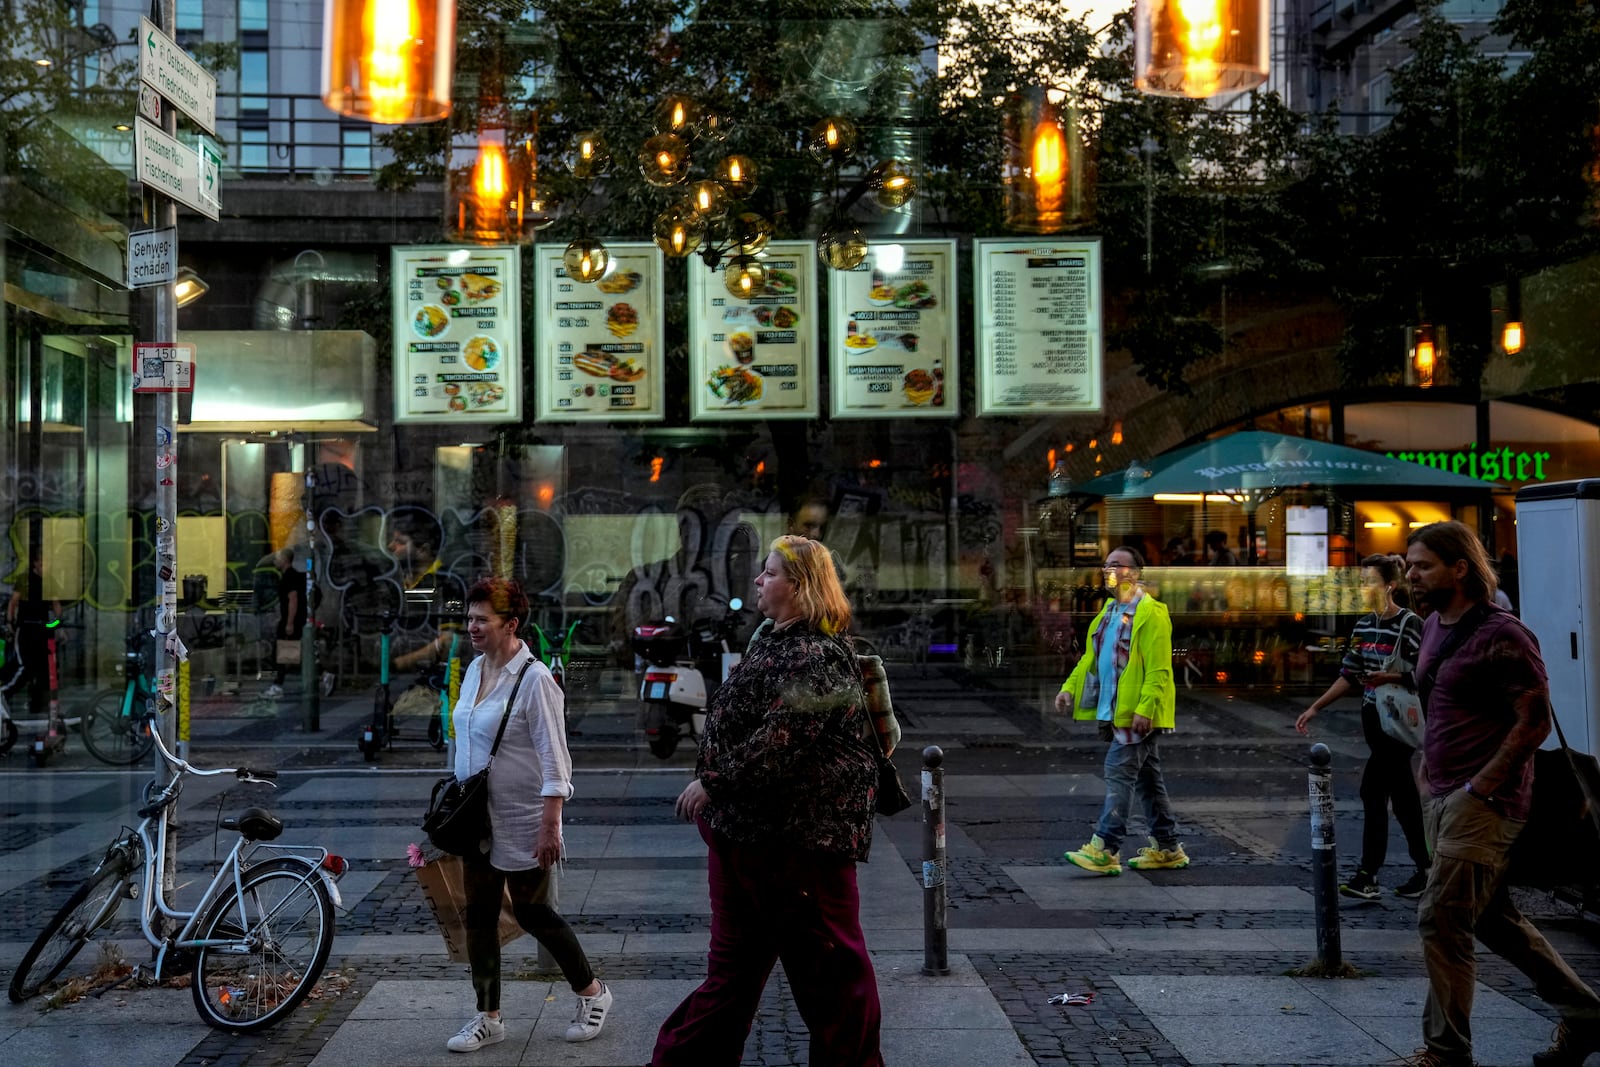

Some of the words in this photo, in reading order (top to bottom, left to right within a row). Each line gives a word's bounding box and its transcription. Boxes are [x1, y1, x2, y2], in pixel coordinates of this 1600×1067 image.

[167, 48, 198, 88] Ostbahnhof
[159, 67, 198, 113] Friedrichshain
[144, 130, 170, 160] Potsdamer
[144, 156, 183, 192] Fischerinsel
[134, 241, 171, 257] Gehweg-
[155, 349, 176, 359] 150
